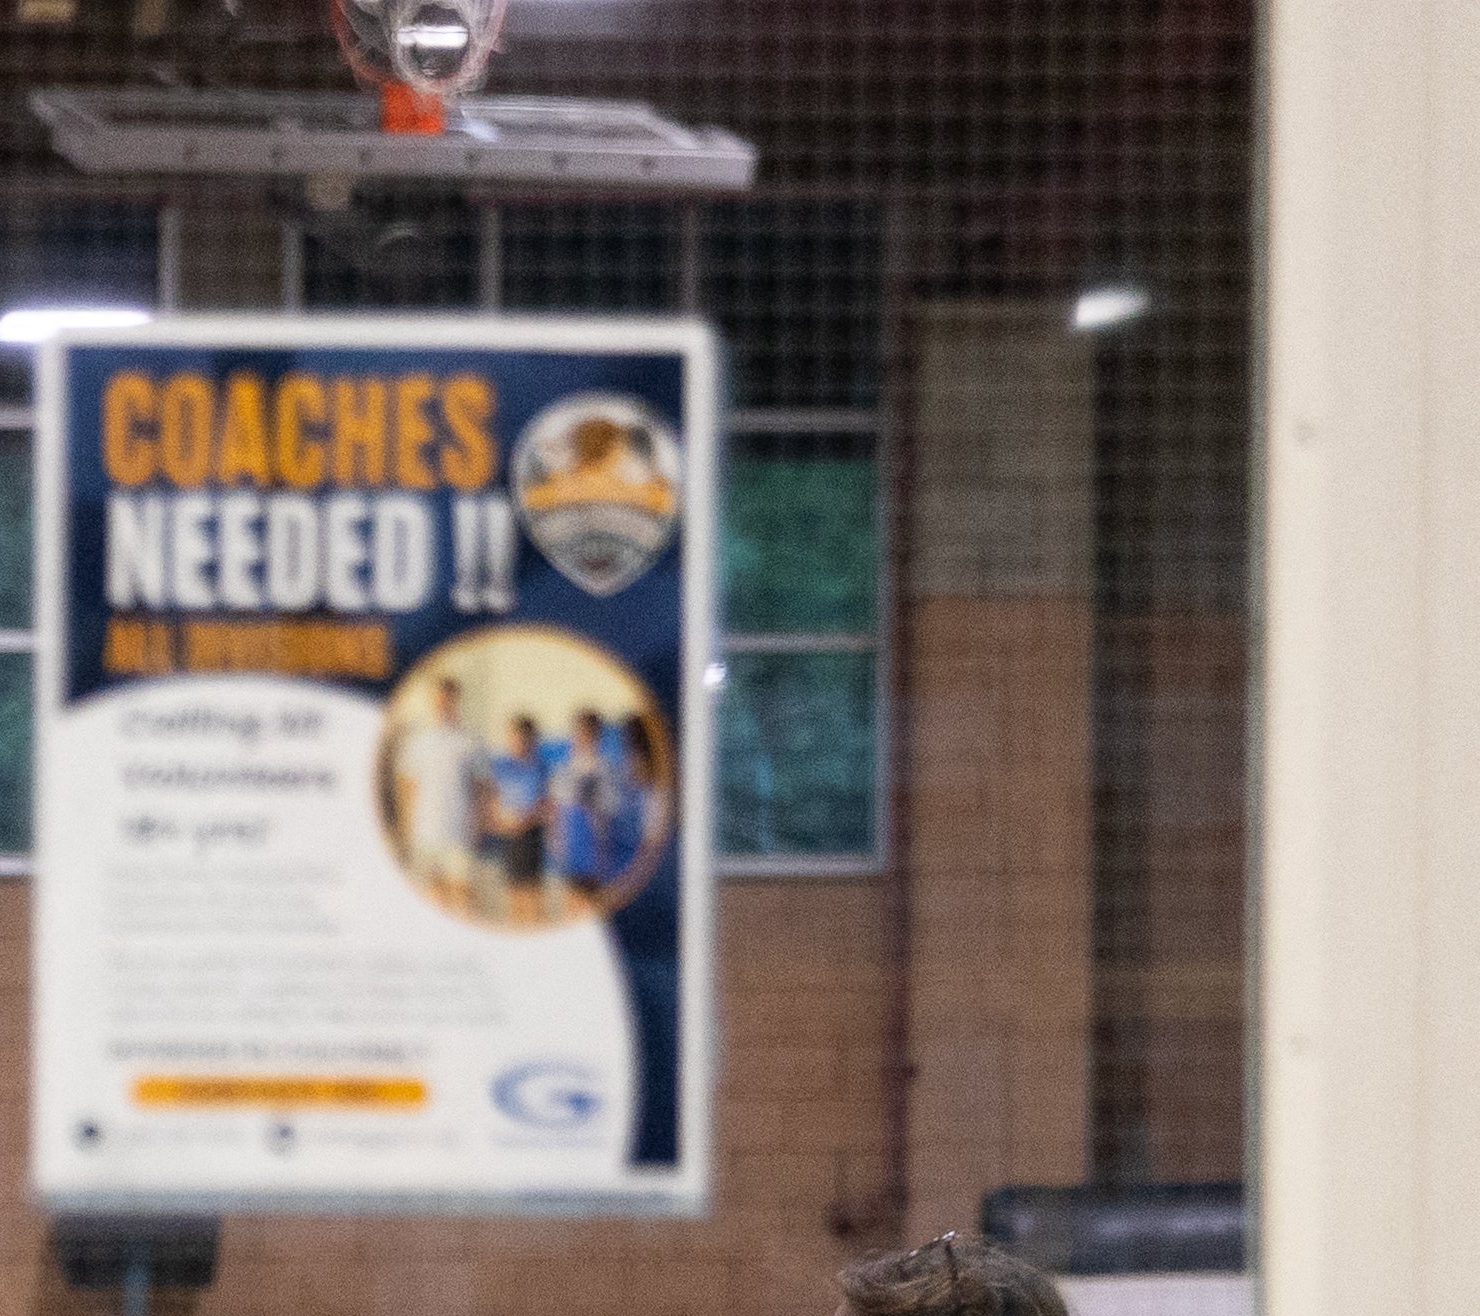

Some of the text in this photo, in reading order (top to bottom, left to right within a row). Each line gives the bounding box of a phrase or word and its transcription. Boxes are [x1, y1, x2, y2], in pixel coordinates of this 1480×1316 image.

[103, 370, 498, 490] COACHES
[105, 492, 518, 615] NEEDED !!
